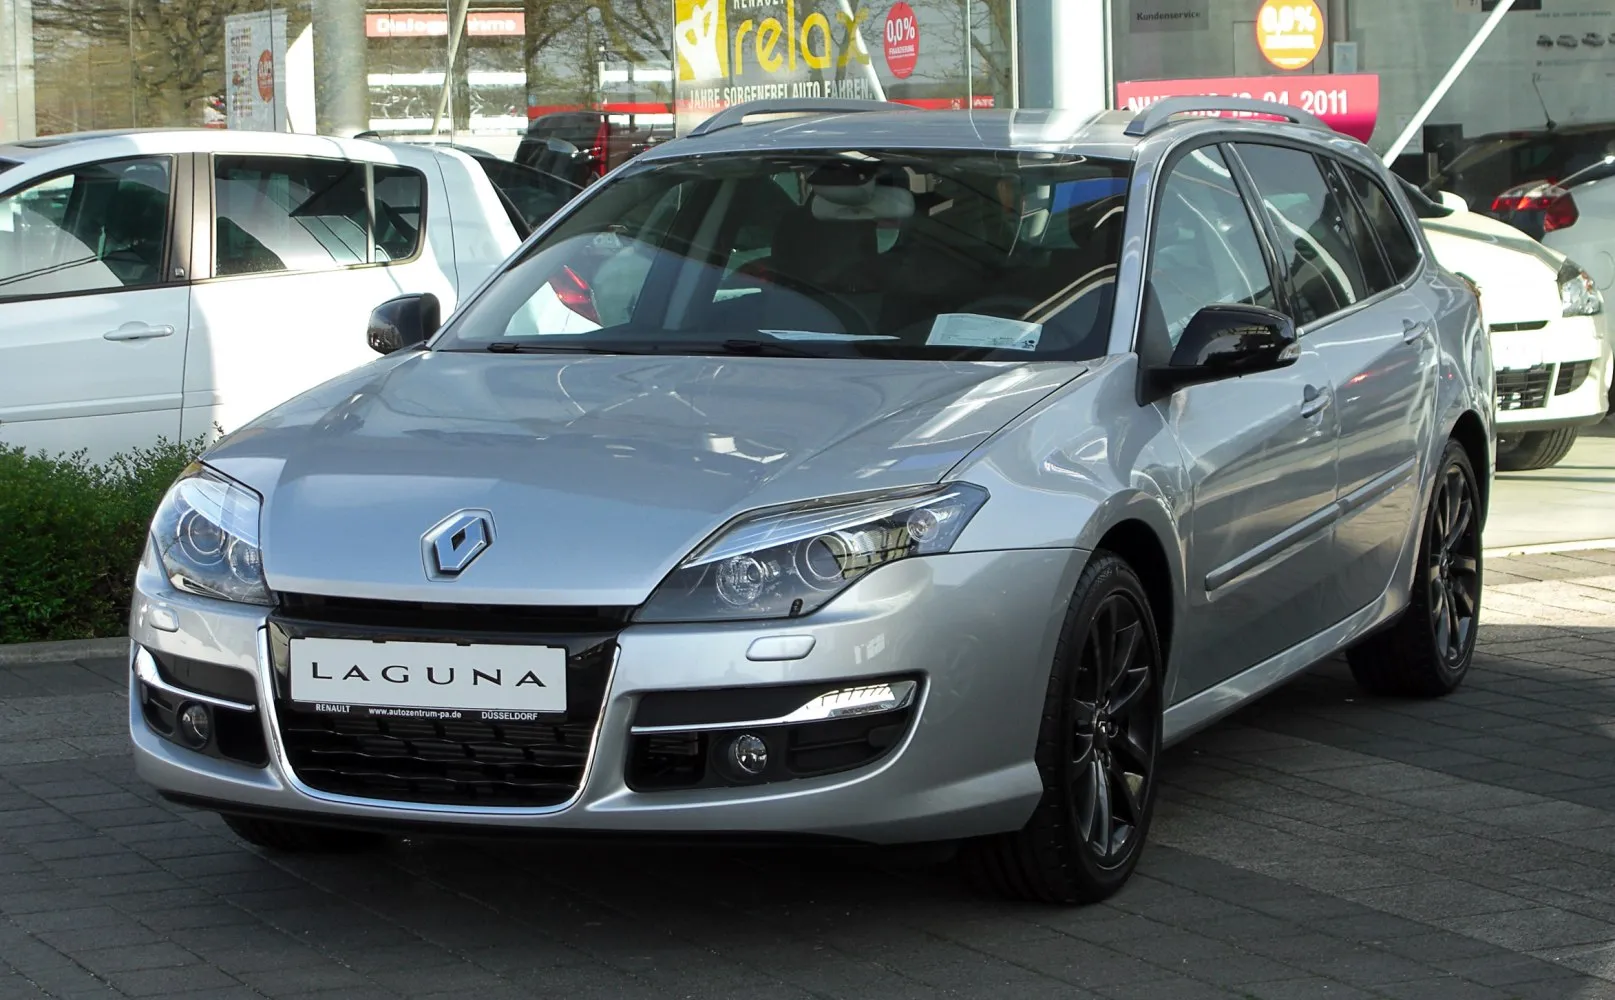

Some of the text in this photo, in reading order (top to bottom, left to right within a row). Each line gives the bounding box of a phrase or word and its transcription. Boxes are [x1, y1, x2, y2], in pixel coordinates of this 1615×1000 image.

[1136, 10, 1201, 21] Kundenservice
[735, 0, 869, 75] relax
[886, 16, 915, 46] 0,0%
[688, 87, 720, 109] JAHRE
[793, 81, 820, 98] AUTO
[312, 662, 547, 688] LAGUNA
[315, 703, 538, 721] RENAULT www.autozentrum-pa.de DÜSSELDORF
